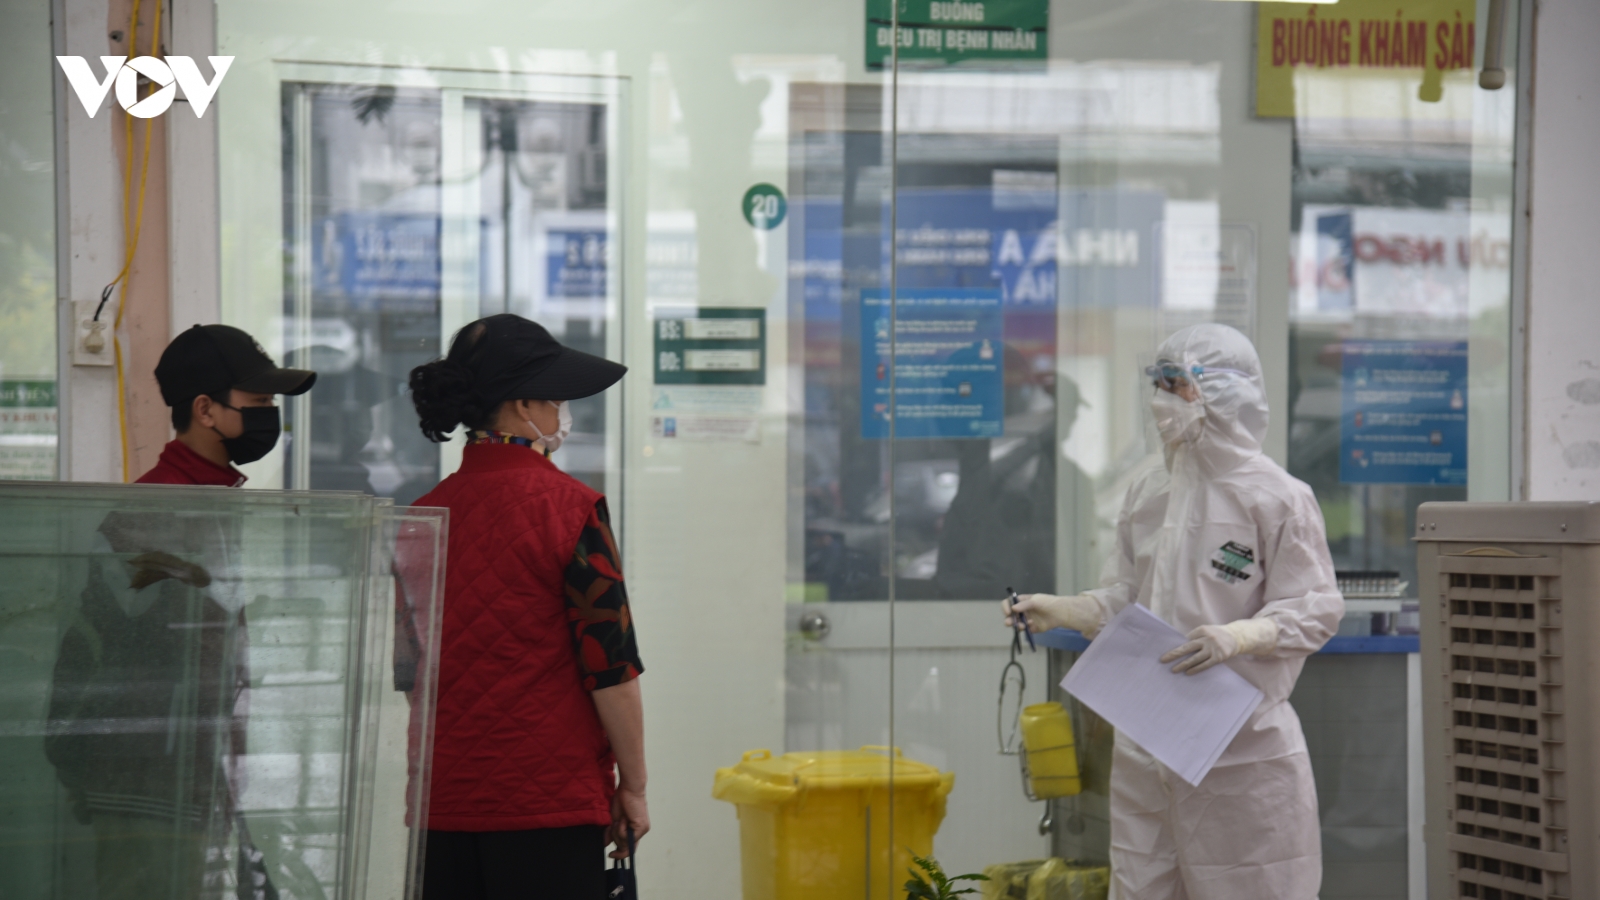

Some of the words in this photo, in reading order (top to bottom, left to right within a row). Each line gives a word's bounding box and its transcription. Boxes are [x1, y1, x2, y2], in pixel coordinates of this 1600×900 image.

[917, 29, 942, 52] TRỊ
[945, 28, 988, 53] BỆNH
[991, 28, 1037, 50] NHÂN
[1359, 9, 1427, 68] KHÁM
[751, 194, 779, 218] 20
